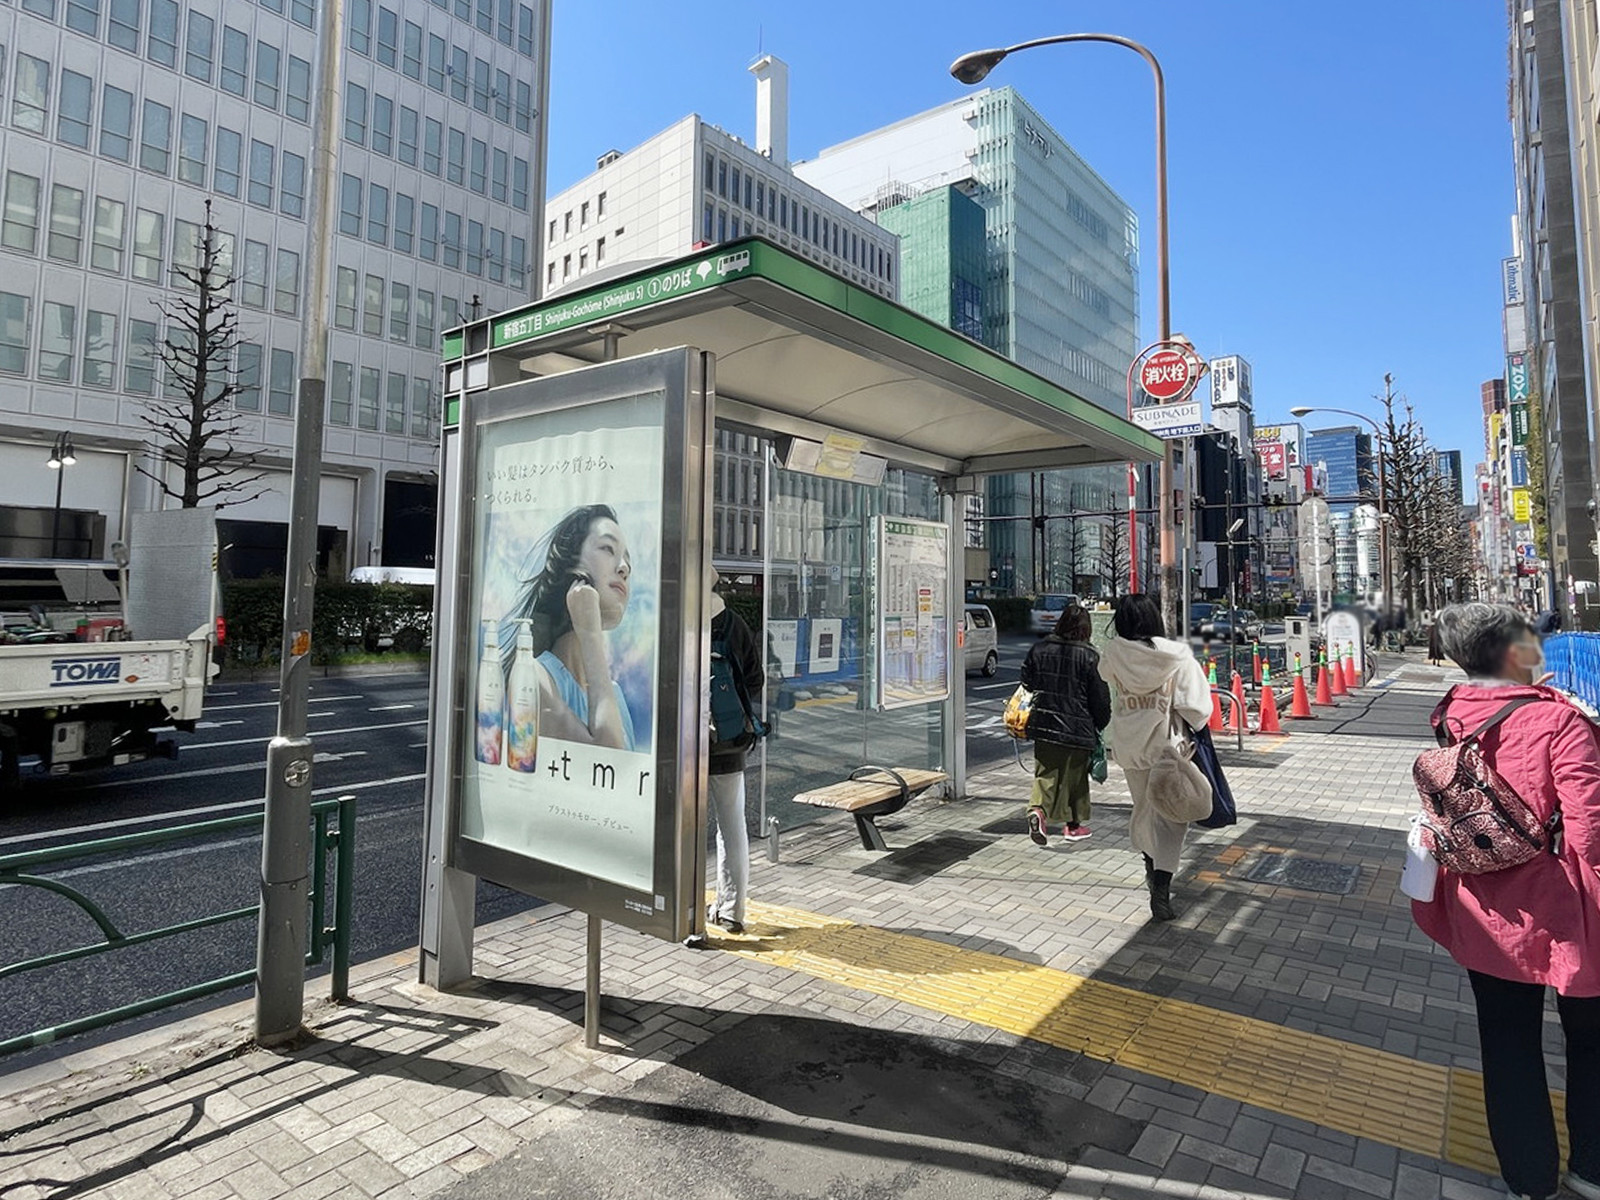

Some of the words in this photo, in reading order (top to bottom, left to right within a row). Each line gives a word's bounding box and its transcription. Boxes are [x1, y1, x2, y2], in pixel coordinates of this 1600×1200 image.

[503, 313, 542, 340] 新宿五丁目
[1145, 362, 1186, 386] 消火栓
[1511, 364, 1526, 400] NOVA
[1137, 405, 1198, 422] SUBNADE
[51, 662, 121, 682] TOWA
